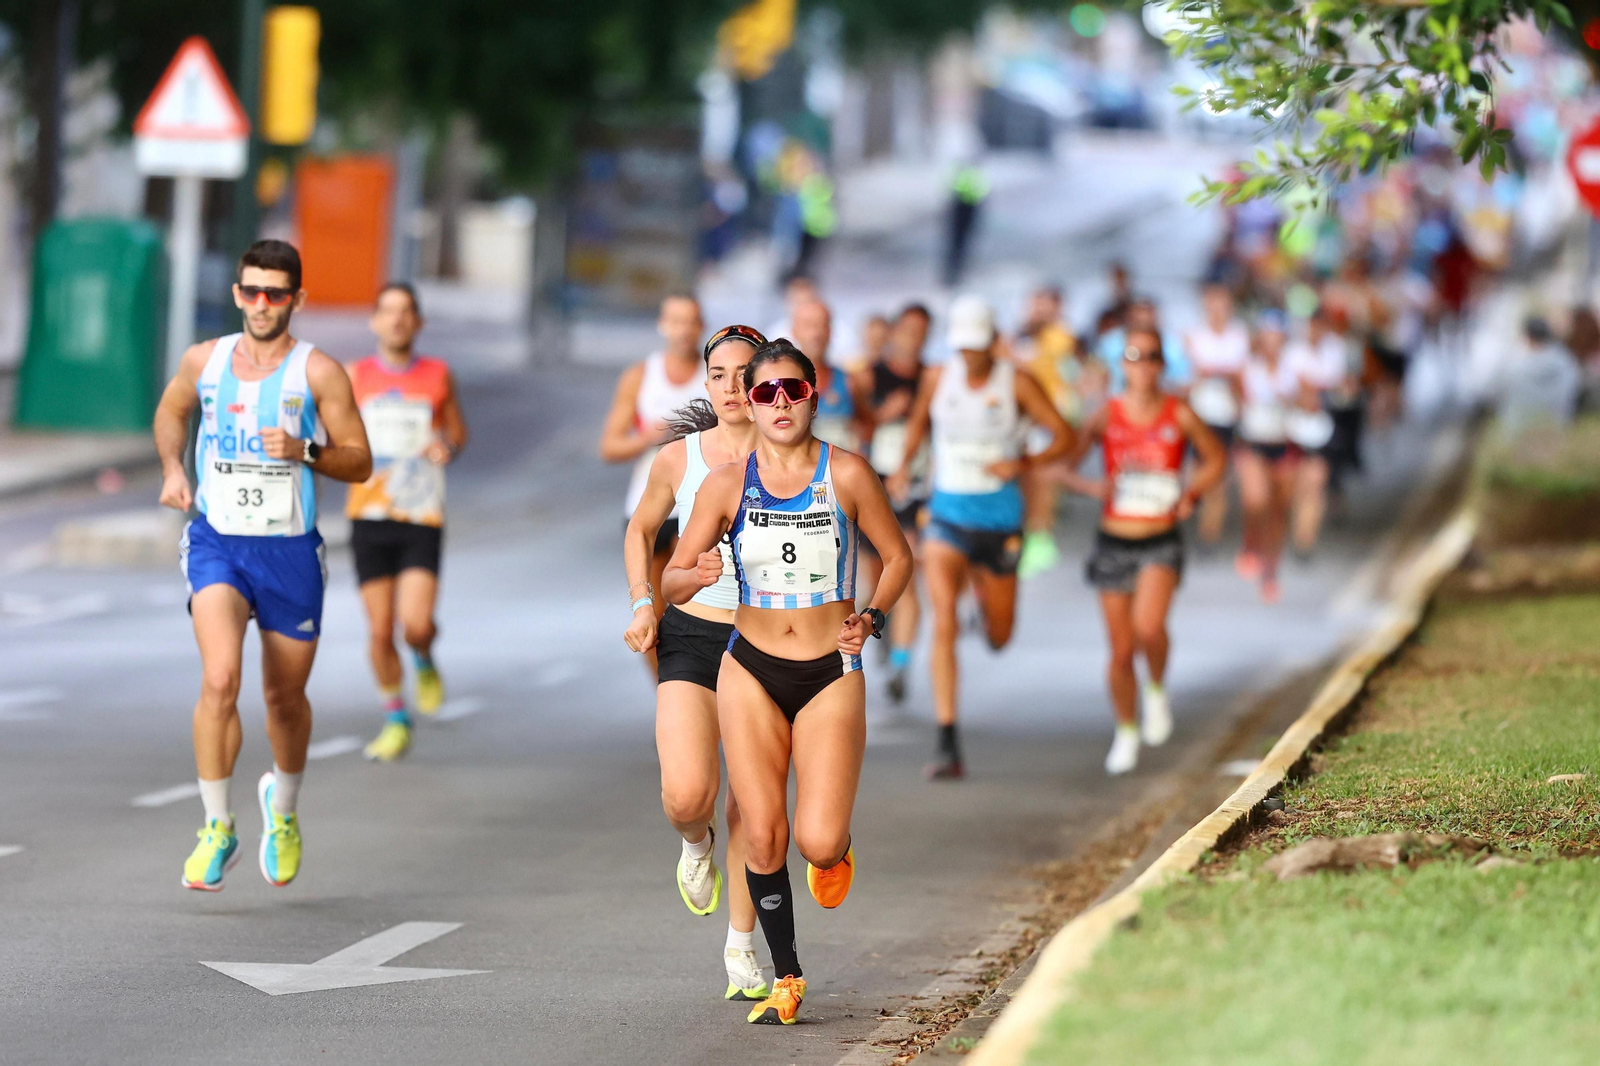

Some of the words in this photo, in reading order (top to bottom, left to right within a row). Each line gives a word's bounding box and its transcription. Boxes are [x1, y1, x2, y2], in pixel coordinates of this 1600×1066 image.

[214, 461, 233, 474] 43
[237, 488, 263, 507] 33
[748, 511, 769, 528] 43
[804, 511, 830, 519] URBANA
[781, 542, 797, 564] 8
